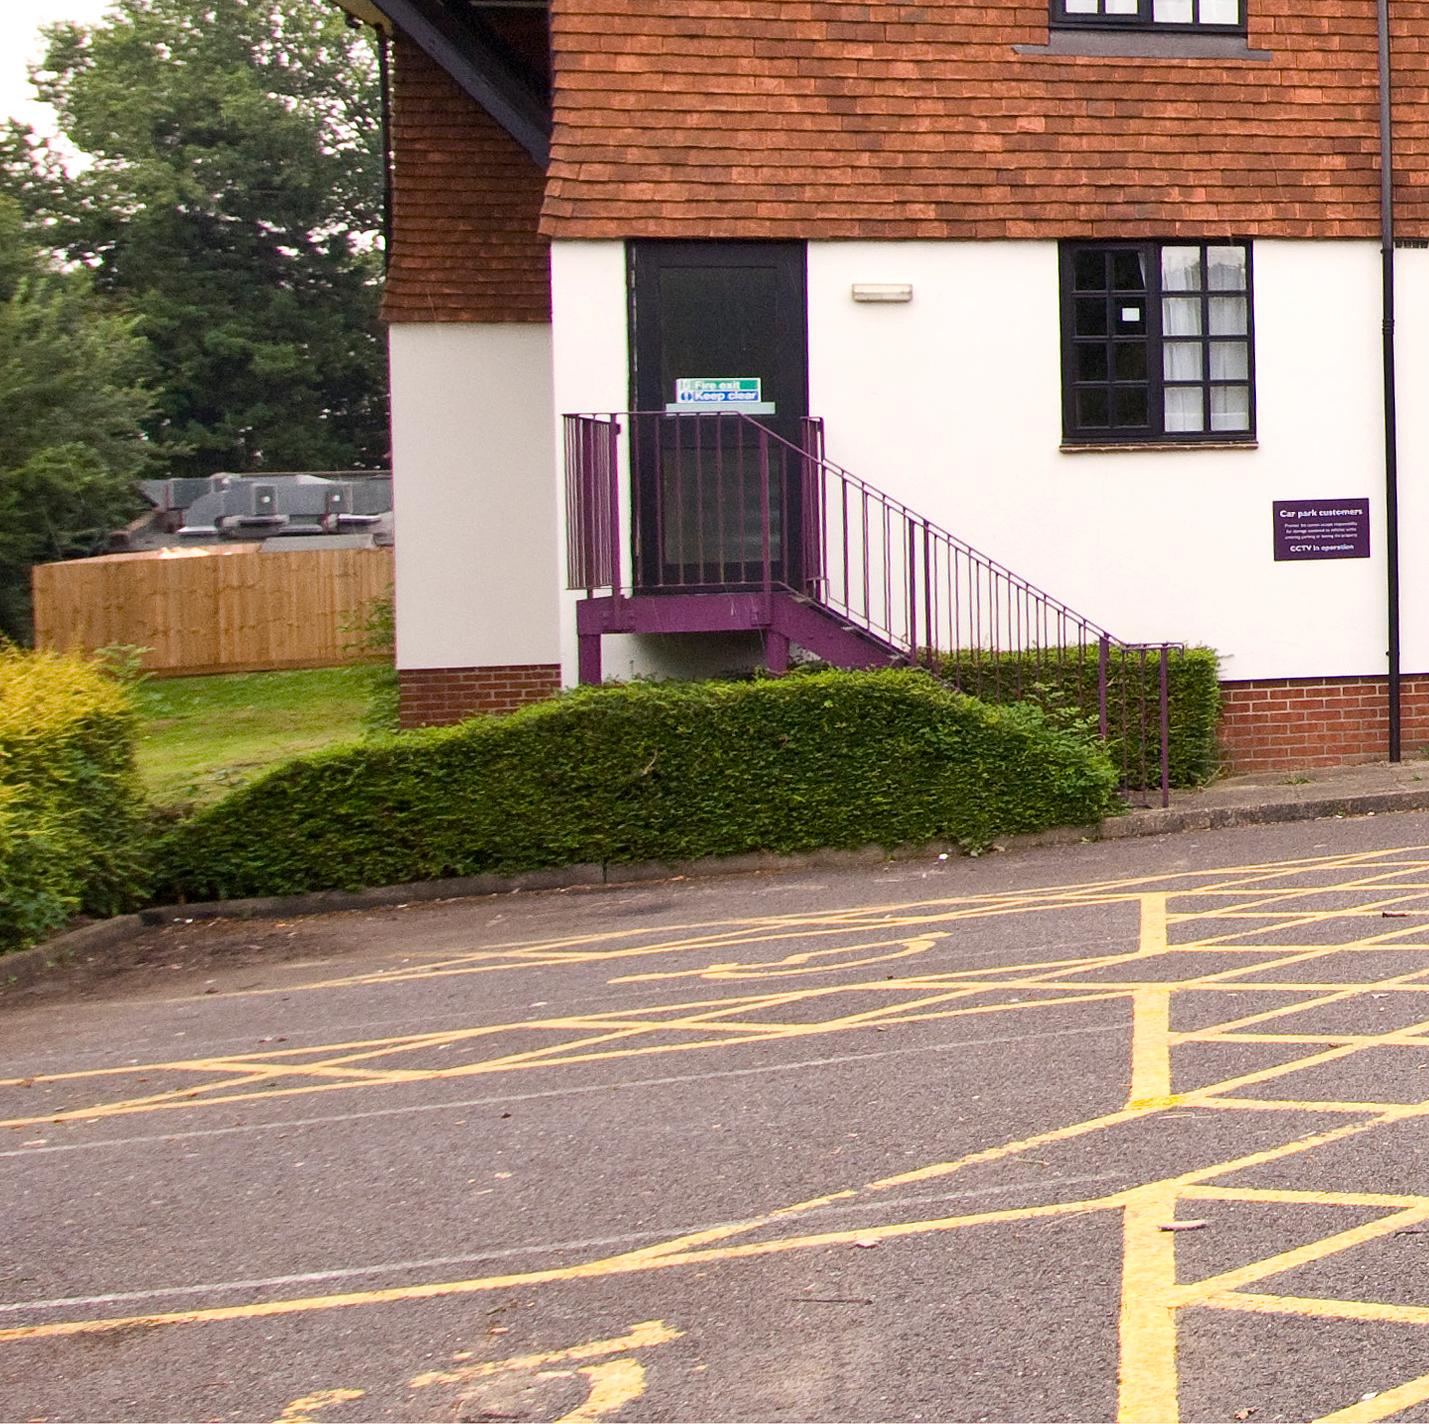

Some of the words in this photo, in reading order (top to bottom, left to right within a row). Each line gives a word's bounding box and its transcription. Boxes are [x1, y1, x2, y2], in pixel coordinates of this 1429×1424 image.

[695, 380, 717, 390] Fire
[718, 380, 740, 389] exit
[695, 391, 726, 401] Keep
[727, 391, 756, 400] clear
[1280, 510, 1296, 518] Car
[1298, 509, 1318, 519] park
[1319, 509, 1363, 517] customers
[1313, 544, 1320, 552] in
[1321, 543, 1354, 552] operation
